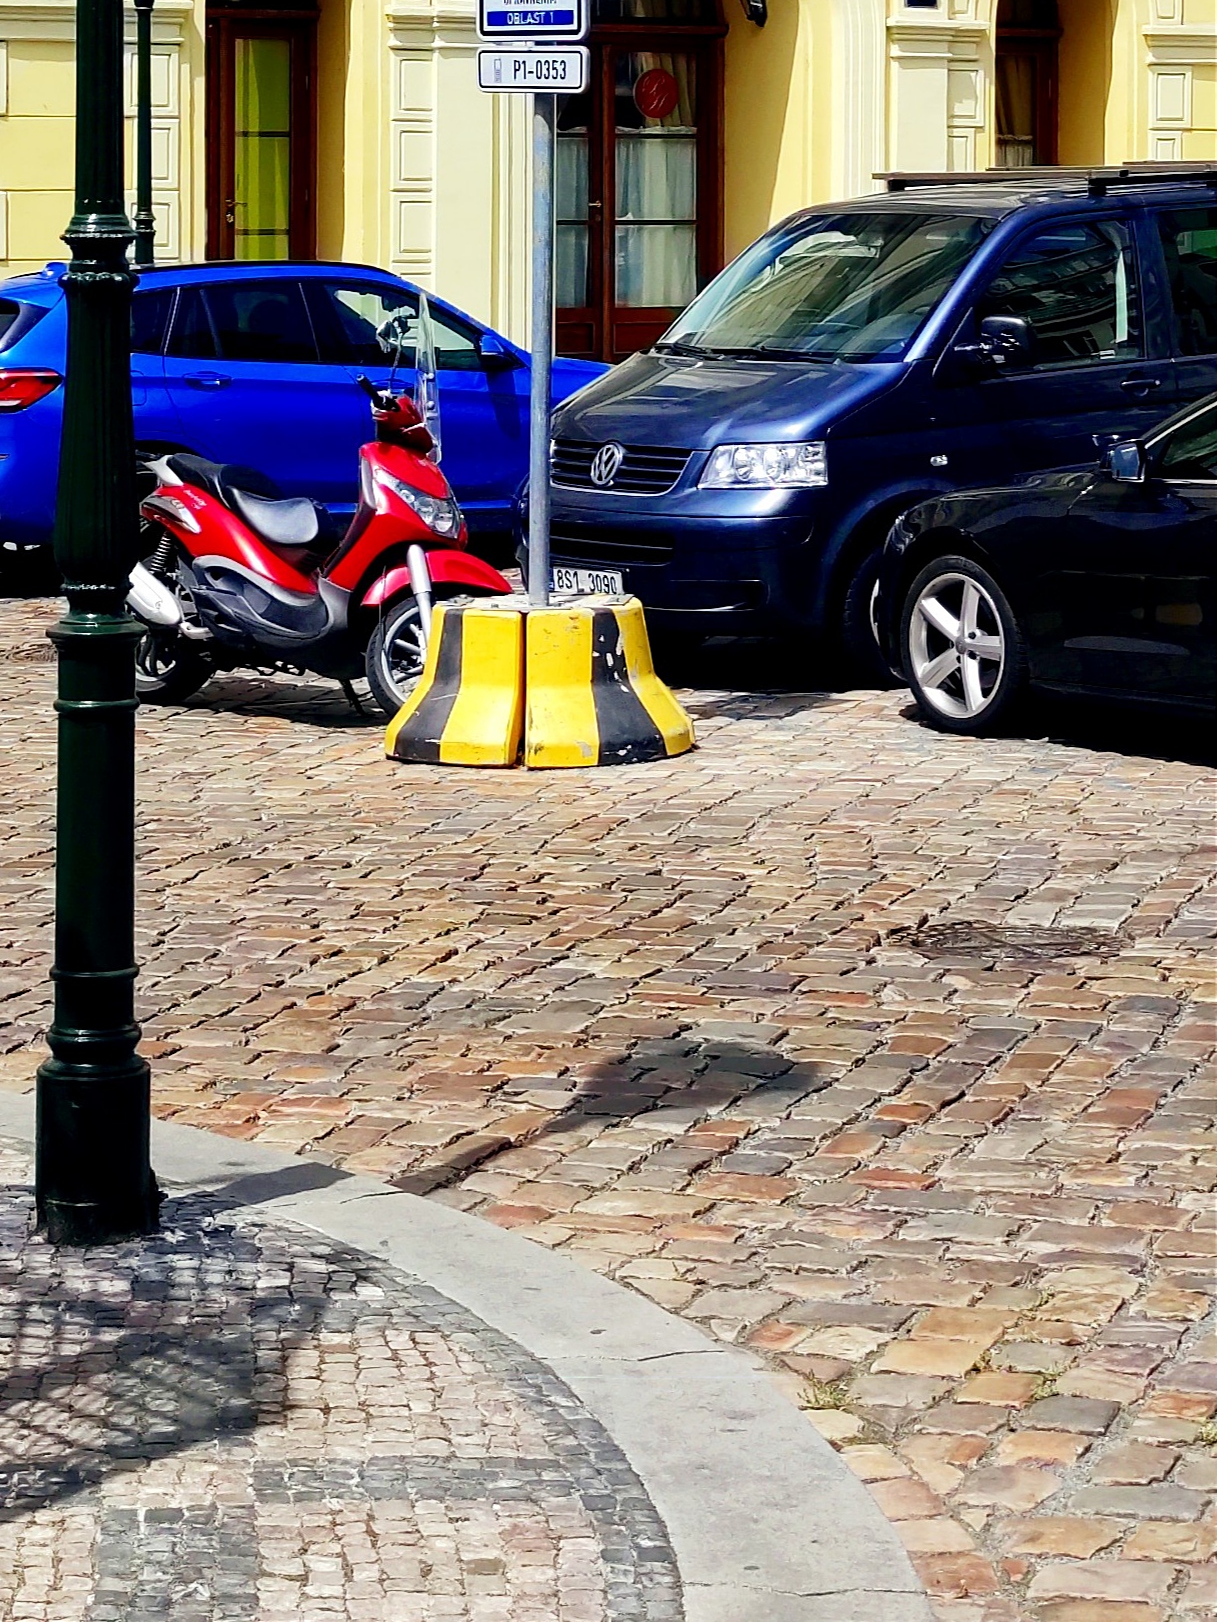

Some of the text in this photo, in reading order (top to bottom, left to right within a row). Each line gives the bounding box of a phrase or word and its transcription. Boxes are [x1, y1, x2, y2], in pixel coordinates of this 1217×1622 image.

[507, 12, 555, 25] OBLAST 1
[513, 60, 567, 80] P1-0353
[556, 569, 618, 594] 8S1 3090
